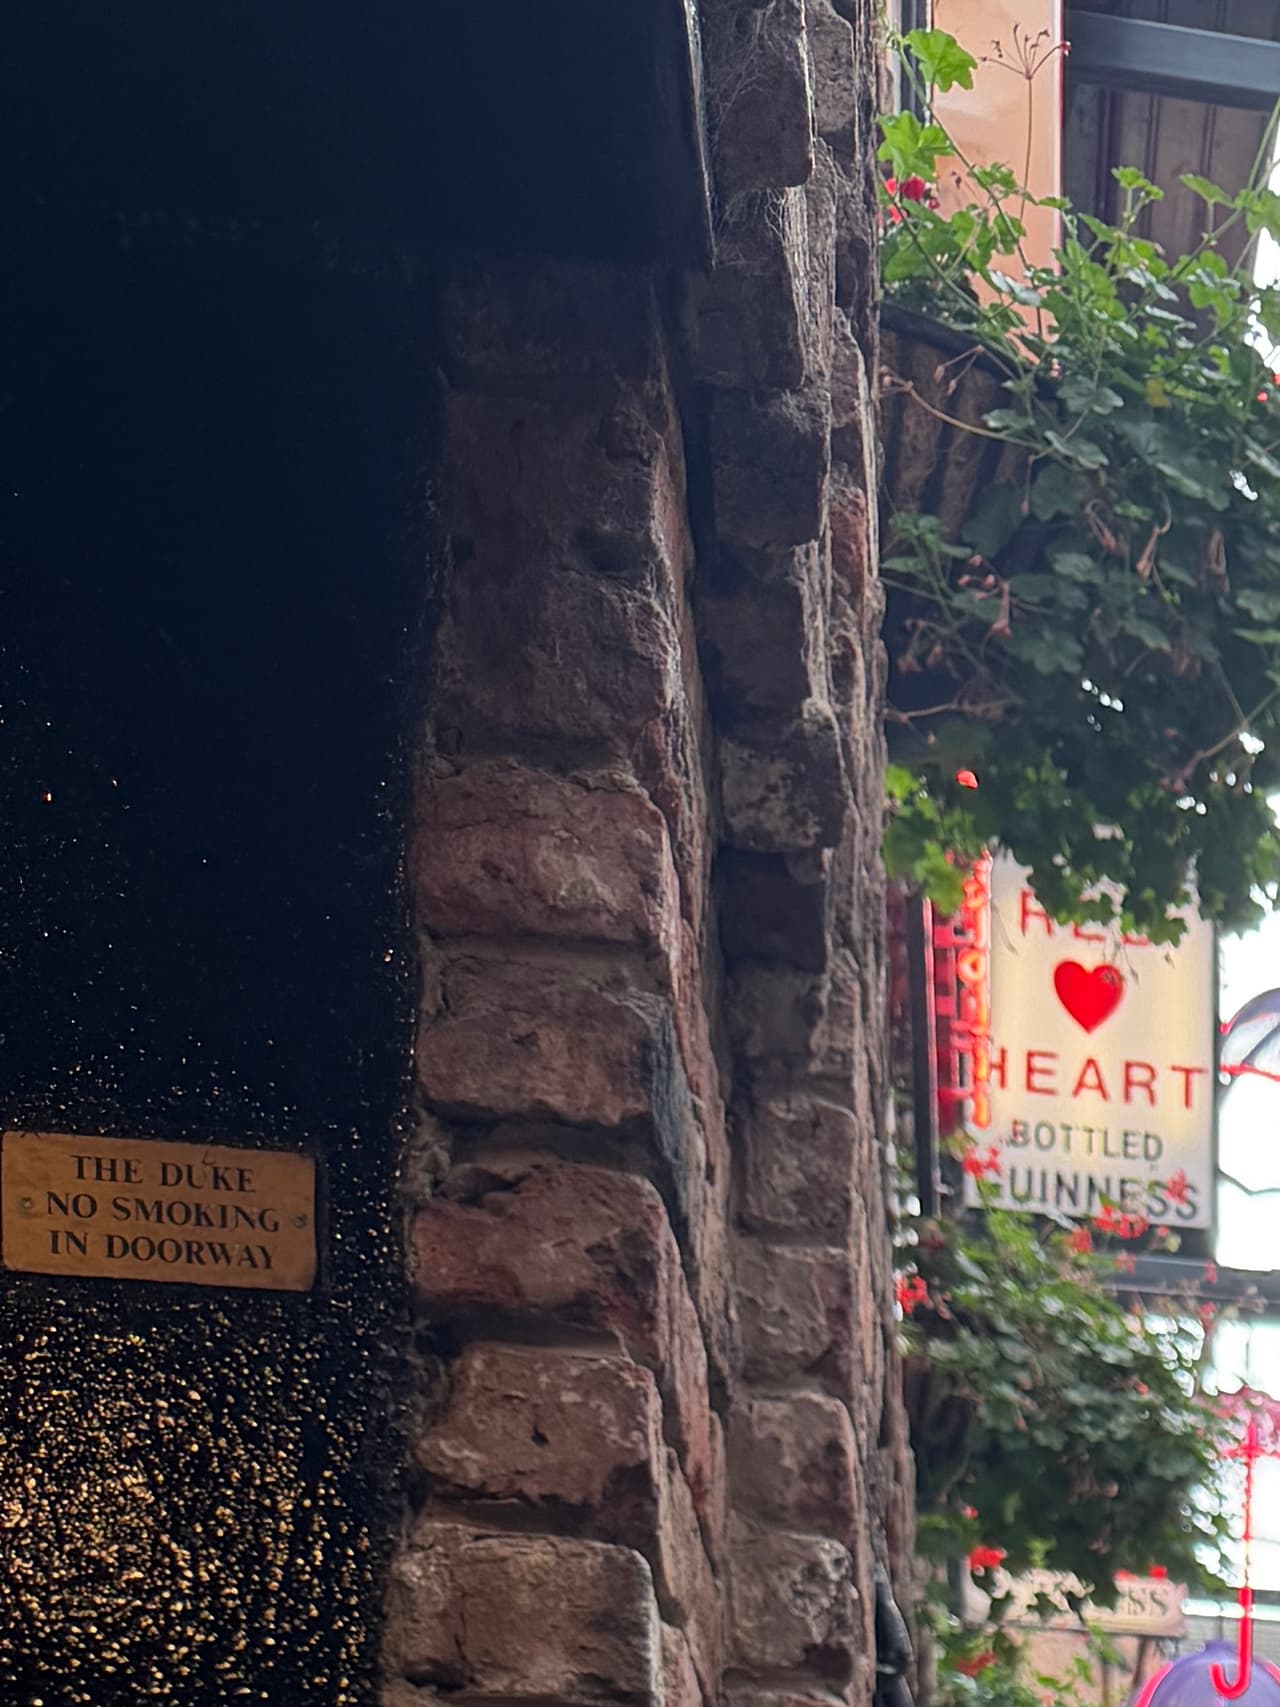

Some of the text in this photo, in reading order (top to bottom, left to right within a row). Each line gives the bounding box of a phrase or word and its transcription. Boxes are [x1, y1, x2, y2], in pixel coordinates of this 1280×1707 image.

[989, 1046, 1205, 1110] HEART
[1012, 1120, 1163, 1161] BOTTLED
[71, 1155, 256, 1193] THE DUKE
[1009, 1168, 1198, 1220] UINNESS
[47, 1191, 280, 1233] NO SMOKING
[50, 1230, 278, 1271] IN DOORWAY
